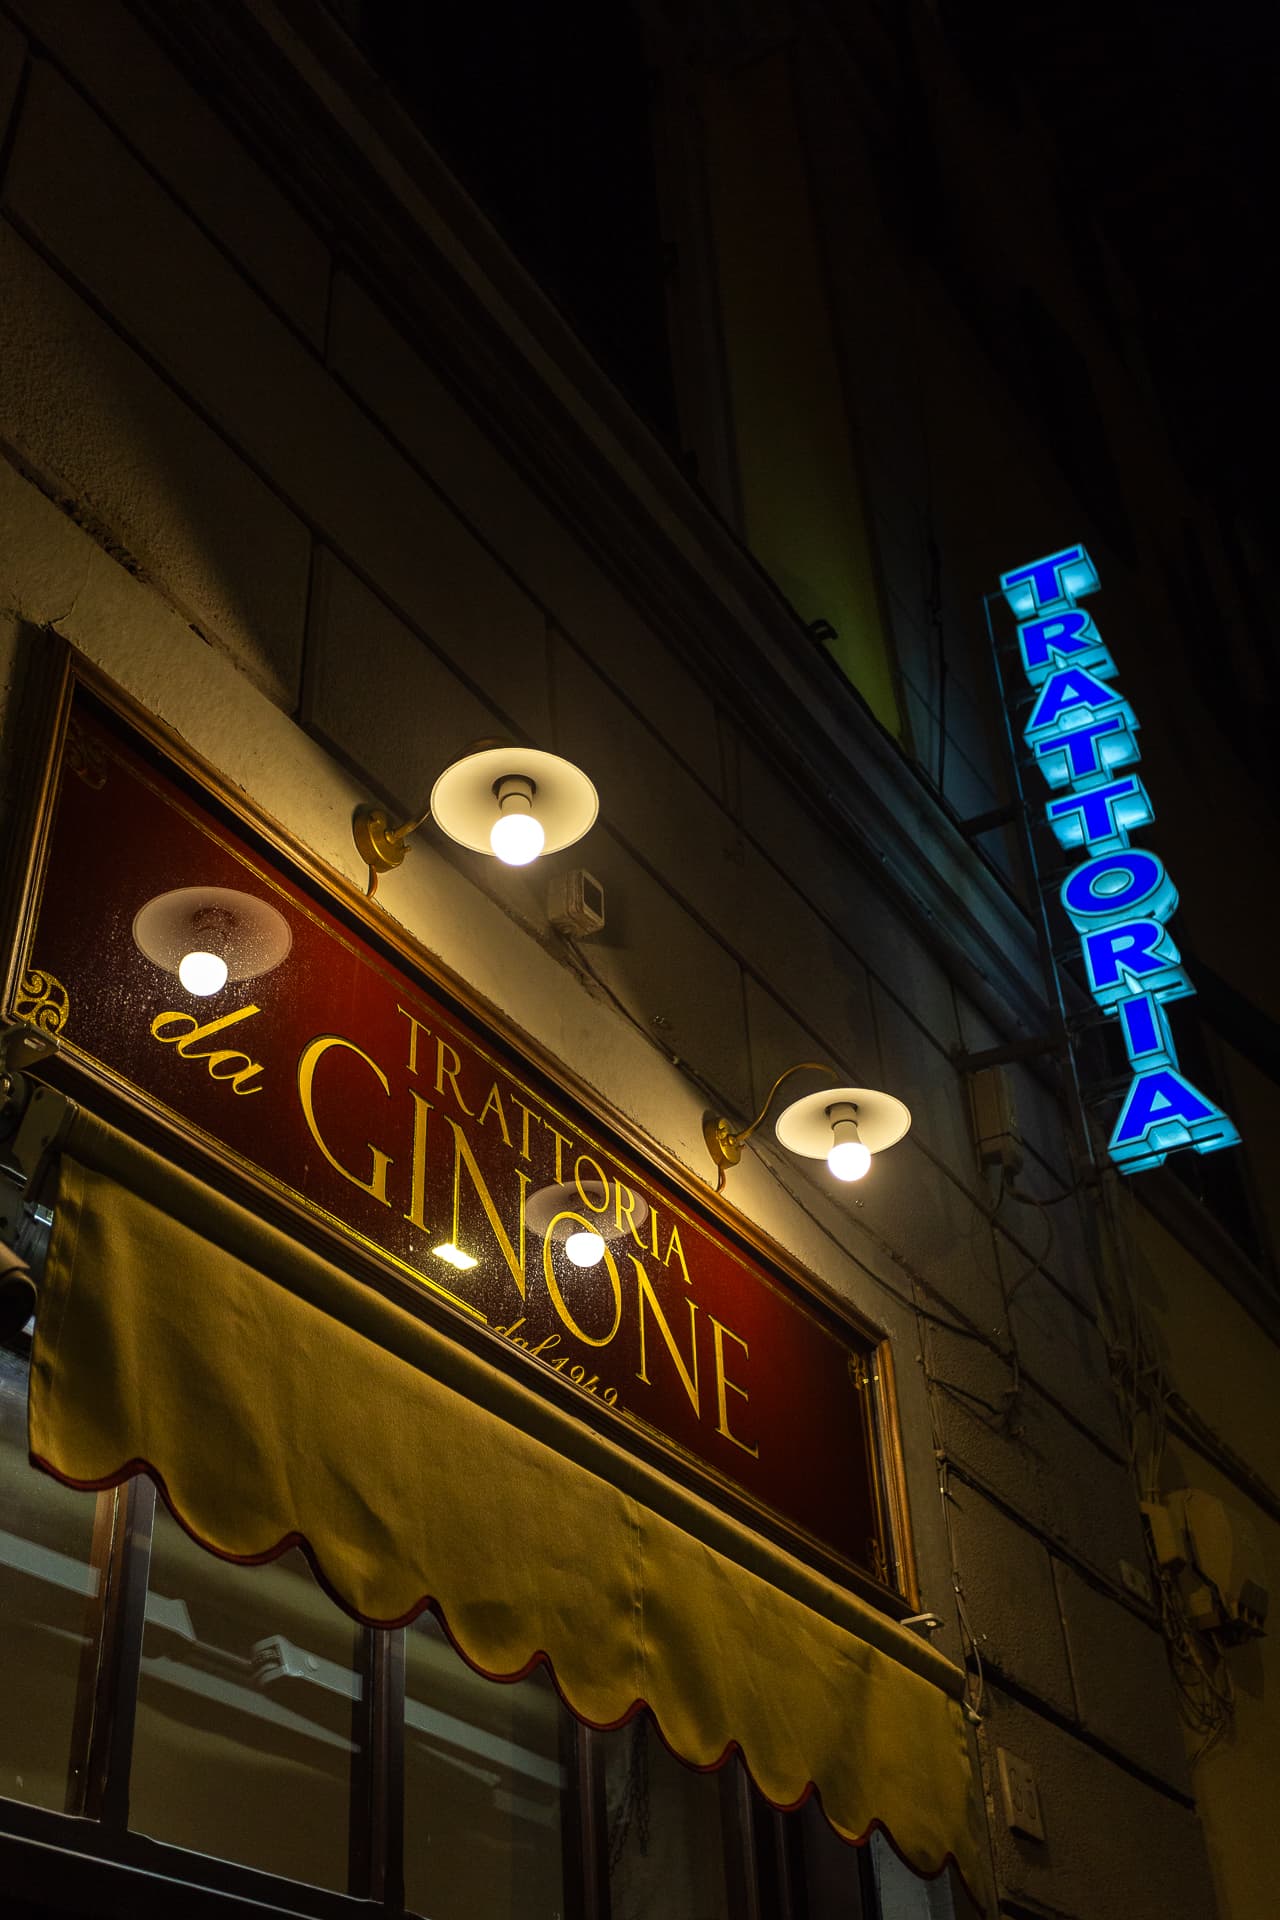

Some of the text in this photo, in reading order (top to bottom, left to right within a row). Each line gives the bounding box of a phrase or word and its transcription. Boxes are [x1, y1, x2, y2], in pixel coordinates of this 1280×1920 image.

[1000, 543, 1240, 1173] TRATTORIA
[150, 1004, 760, 1460] da GINONE
[397, 1004, 693, 1285] TRATTORIA
